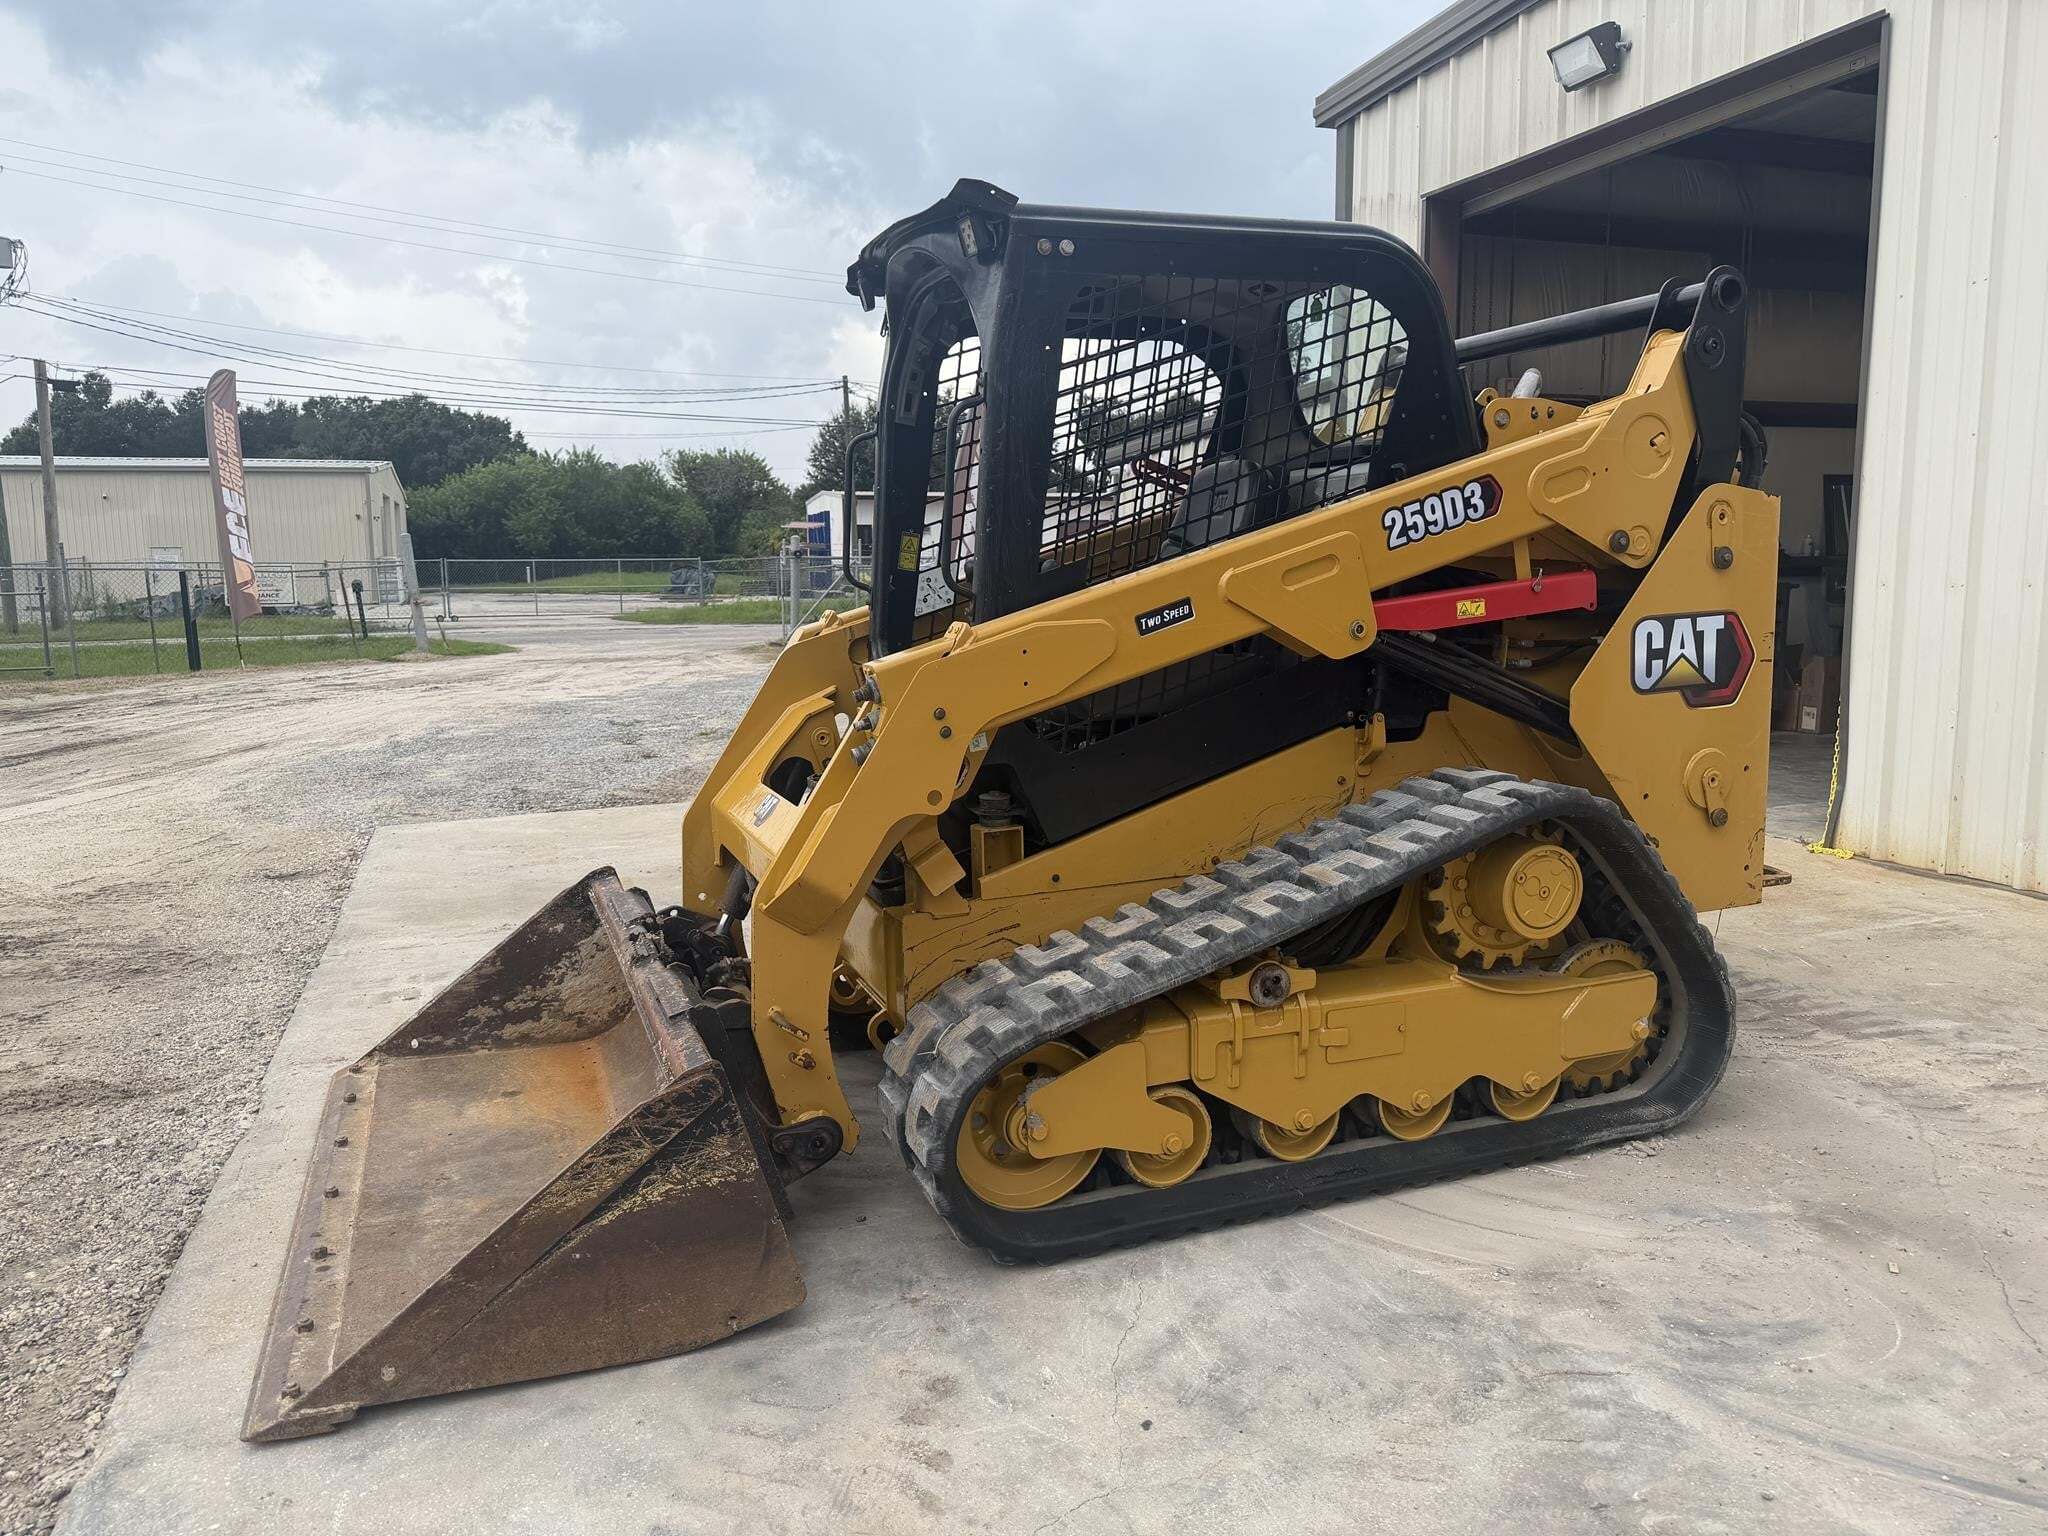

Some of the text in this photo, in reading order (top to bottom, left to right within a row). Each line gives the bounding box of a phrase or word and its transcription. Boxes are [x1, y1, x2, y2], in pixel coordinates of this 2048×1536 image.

[212, 401, 234, 489] EAST COAST
[223, 408, 244, 496] EQUIPMENT
[221, 486, 253, 564] ECE
[1384, 482, 1485, 548] 259D3
[1635, 615, 1725, 690] CAT
